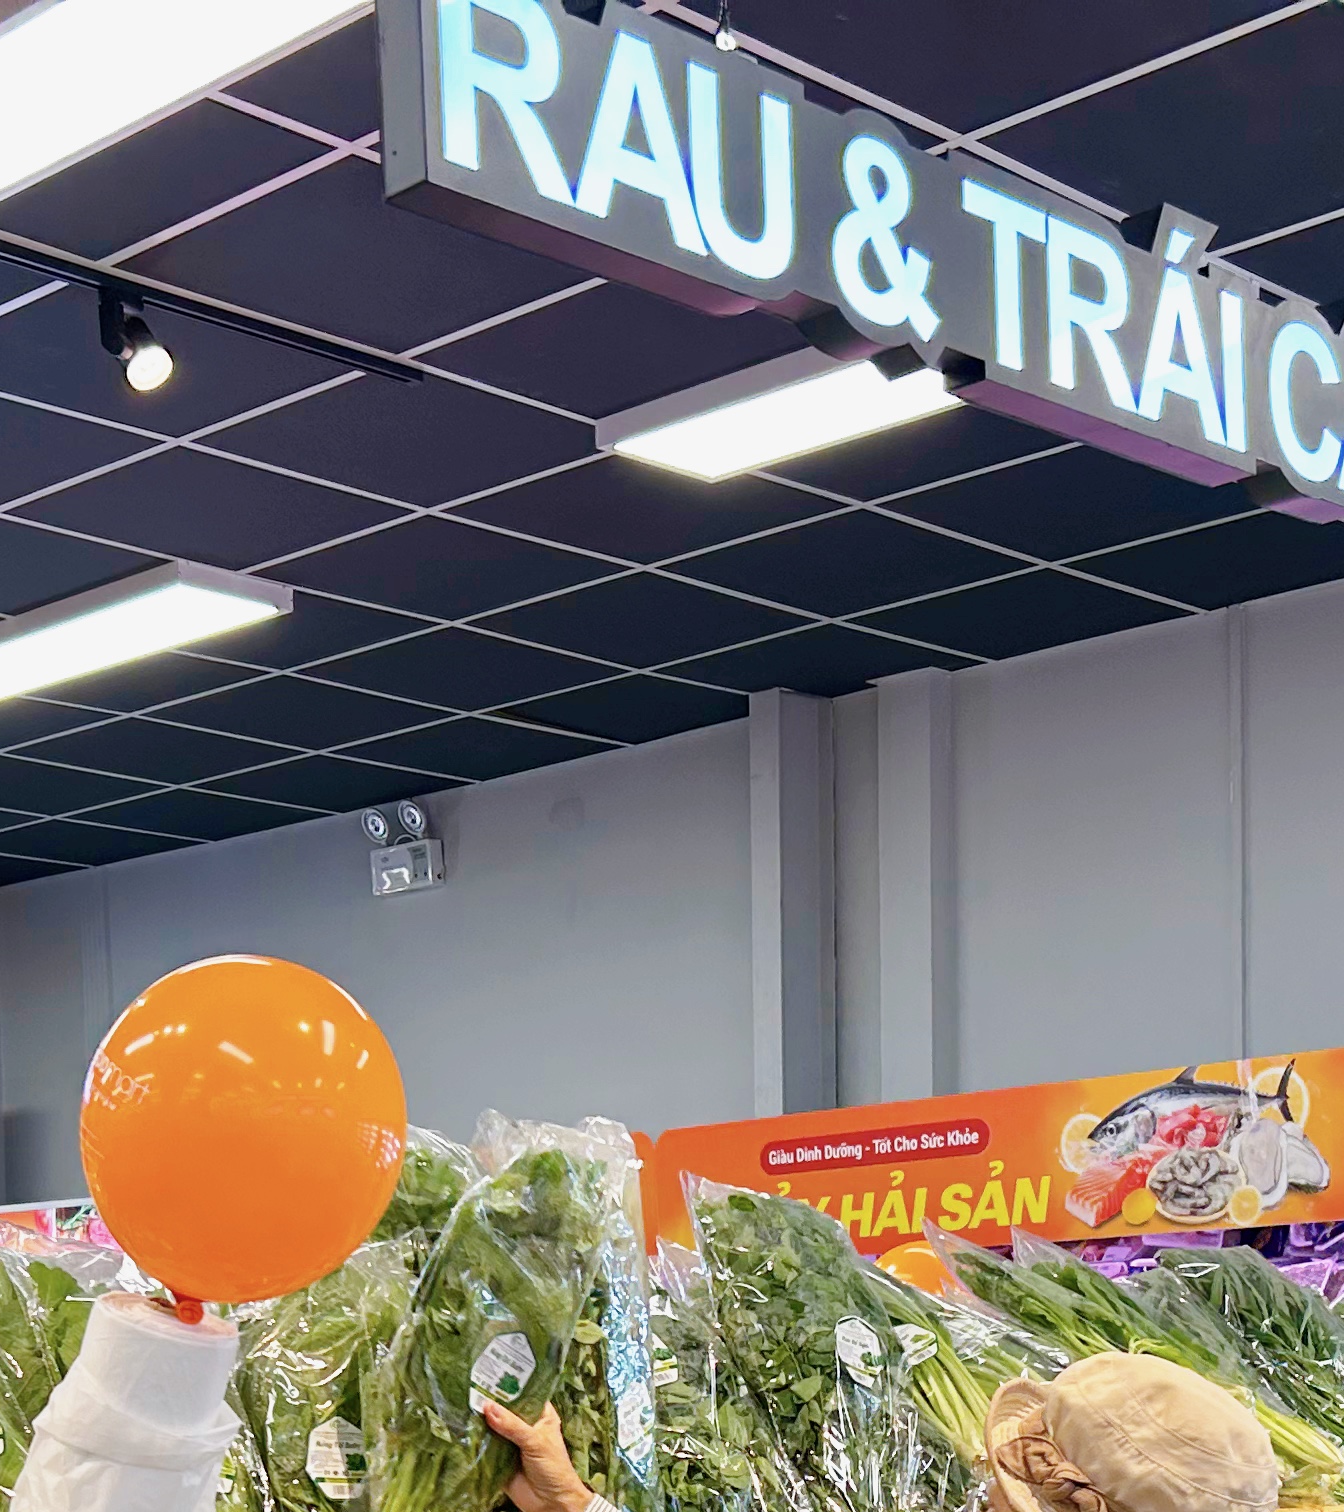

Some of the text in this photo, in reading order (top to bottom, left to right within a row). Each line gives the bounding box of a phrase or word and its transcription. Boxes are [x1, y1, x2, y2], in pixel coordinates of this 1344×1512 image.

[438, 0, 797, 283] RAU
[831, 132, 944, 342] &
[959, 175, 1248, 455] TRÁI
[768, 1148, 794, 1166] Giàu
[796, 1145, 822, 1164] Dinh
[824, 1141, 863, 1162] Dưỡng
[872, 1136, 892, 1154] Tốt
[894, 1134, 918, 1153] Cho
[920, 1130, 945, 1149] Sức
[947, 1126, 980, 1147] Khỏe
[840, 1169, 929, 1238] HẢI
[937, 1160, 1052, 1232] SẢN
